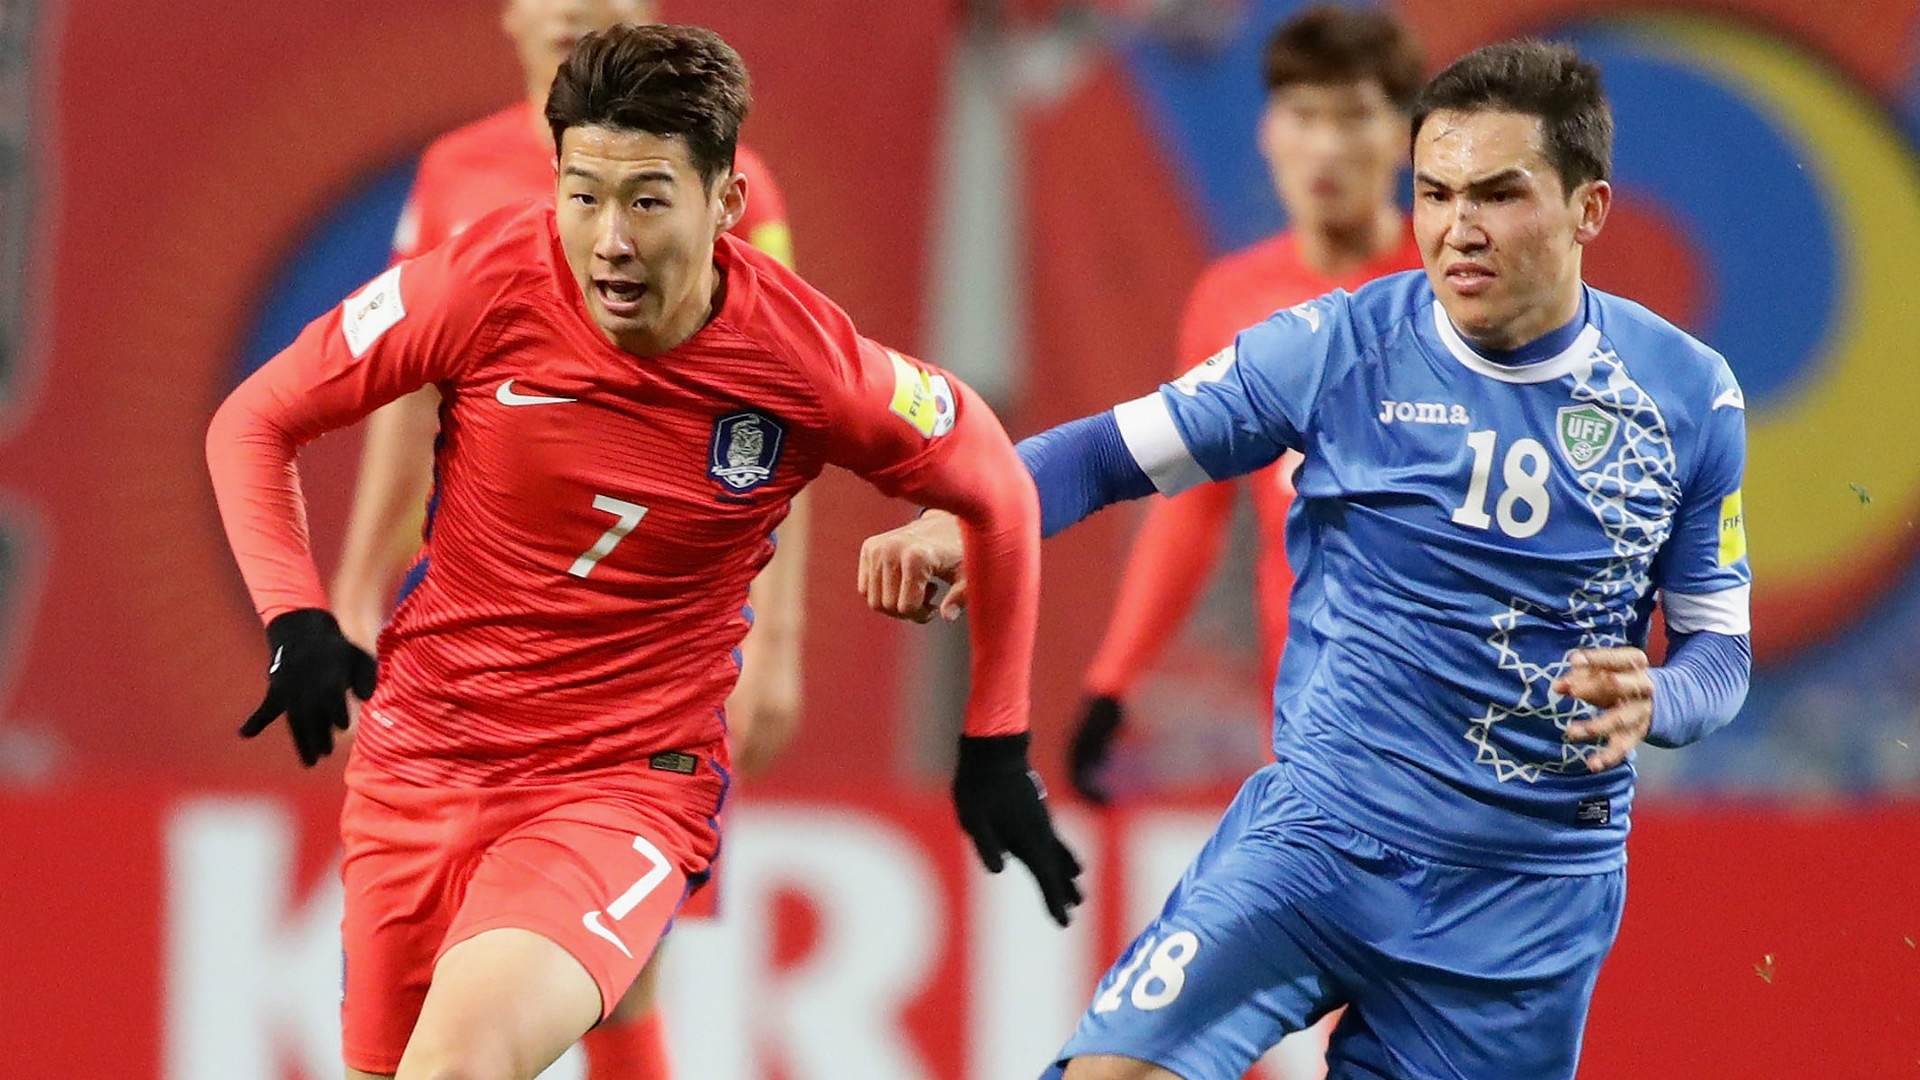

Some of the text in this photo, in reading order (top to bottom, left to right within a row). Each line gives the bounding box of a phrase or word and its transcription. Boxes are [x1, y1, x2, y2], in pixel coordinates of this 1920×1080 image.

[1566, 414, 1608, 443] UFF
[1452, 430, 1550, 538] 18
[1723, 515, 1742, 531] FIF
[568, 494, 649, 578] 7
[605, 835, 673, 921] 7
[1093, 930, 1198, 1014] 18
